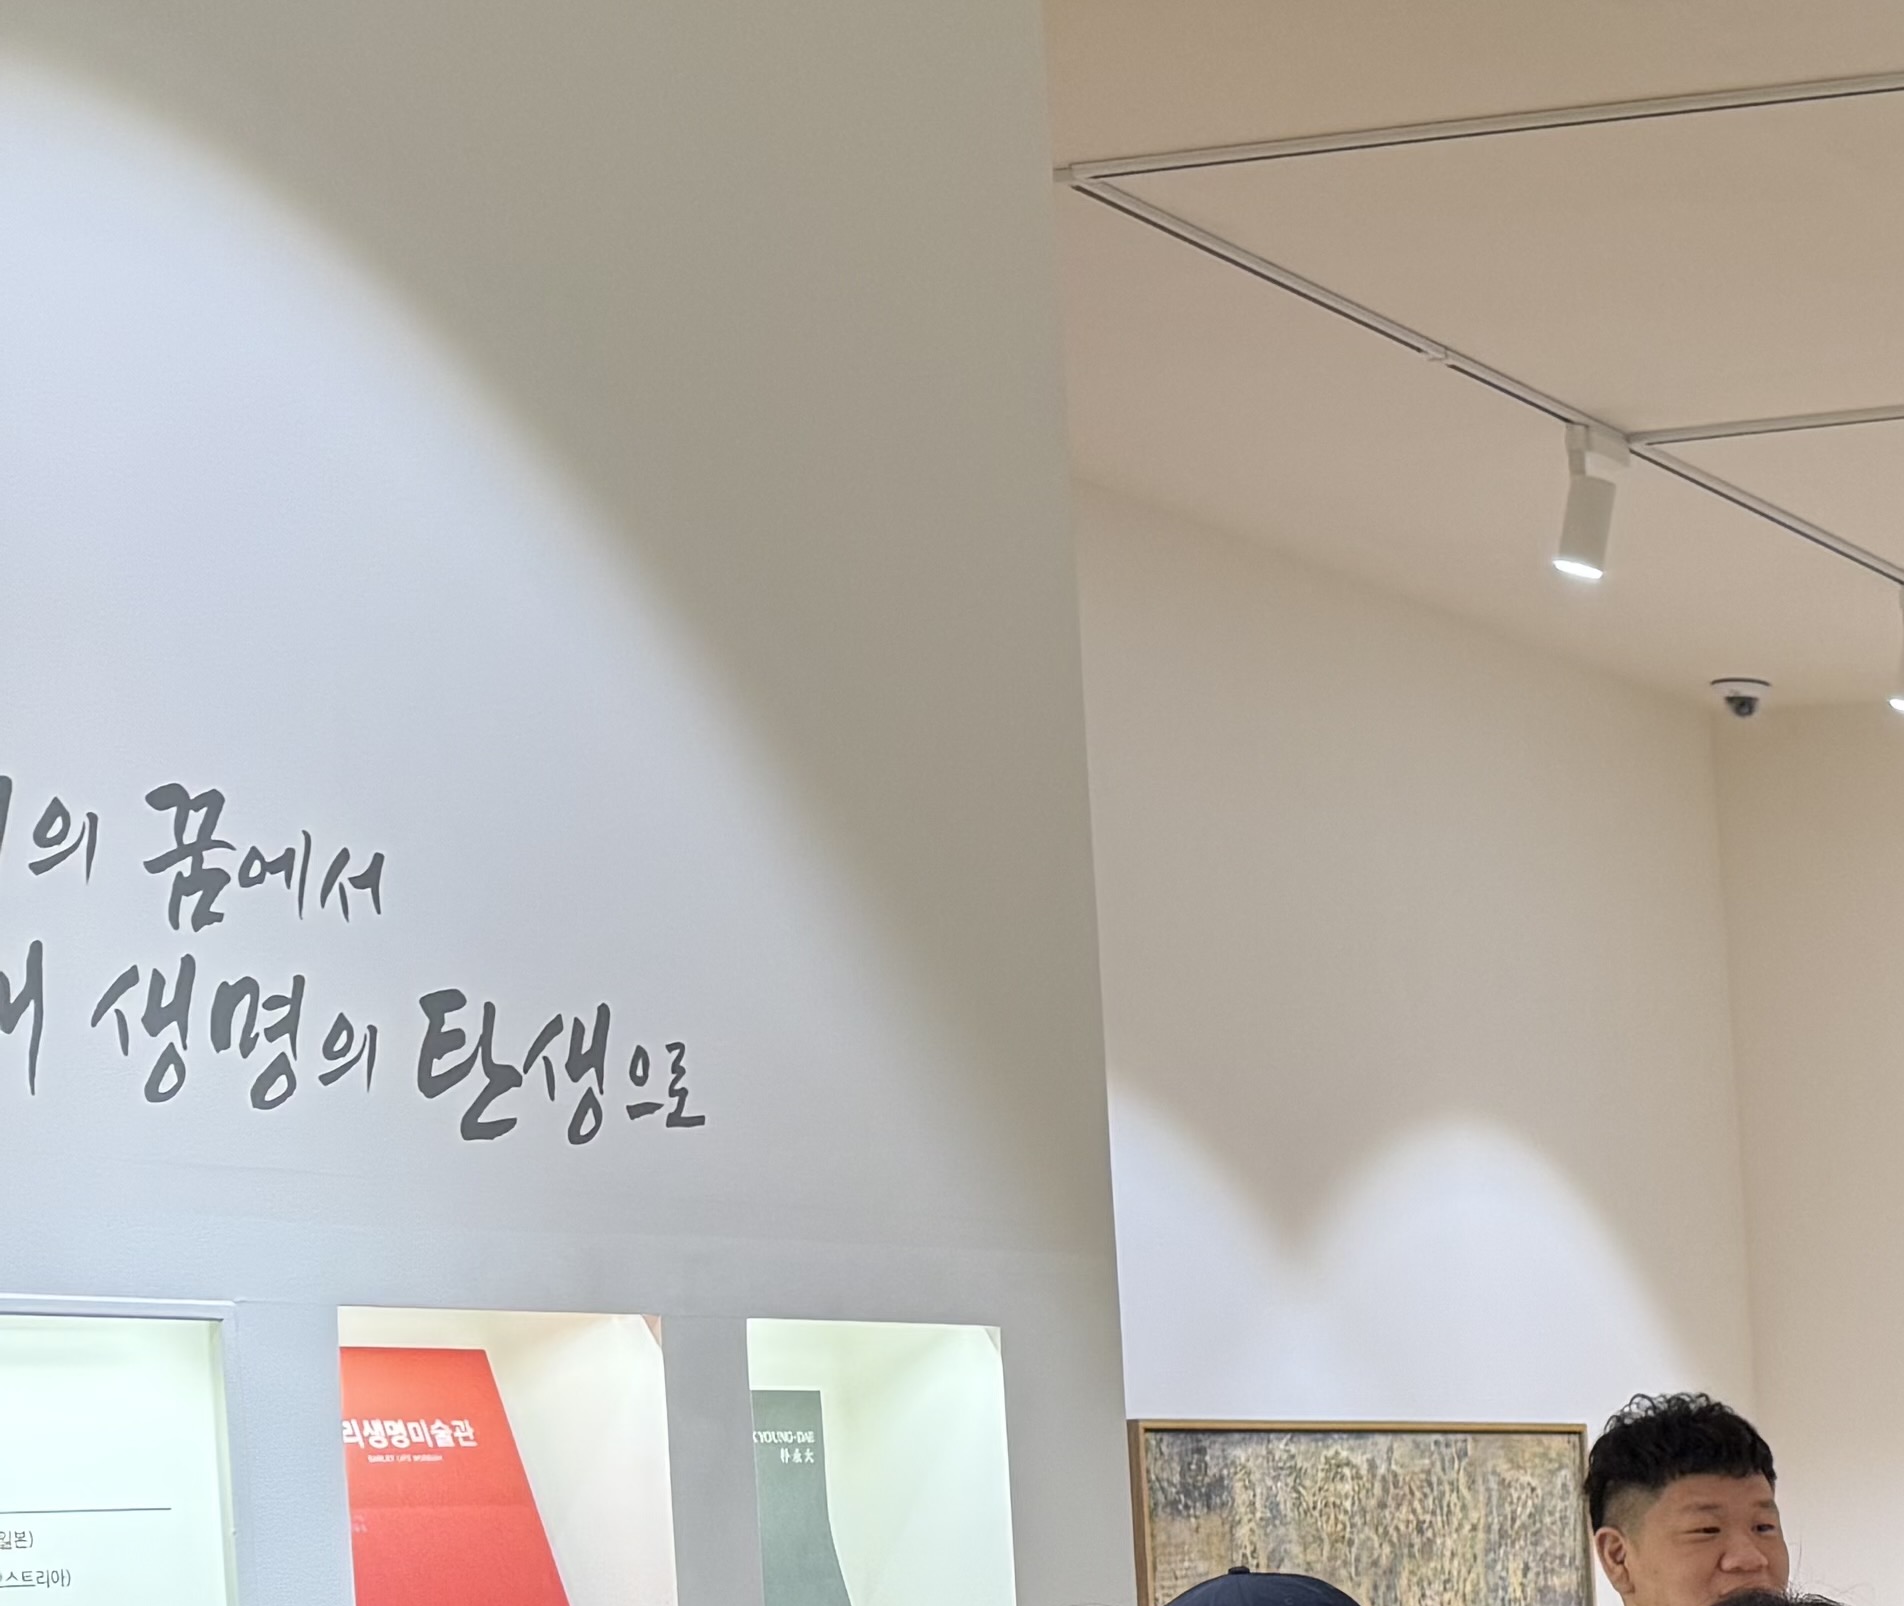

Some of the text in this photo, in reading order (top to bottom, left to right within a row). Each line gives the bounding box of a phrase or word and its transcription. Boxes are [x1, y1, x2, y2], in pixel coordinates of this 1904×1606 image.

[144, 783, 385, 931] 꿈에서
[91, 953, 377, 1110] 생명의
[417, 988, 706, 1145] 탄생으로
[0, 1569, 71, 1588] 스트리아)
